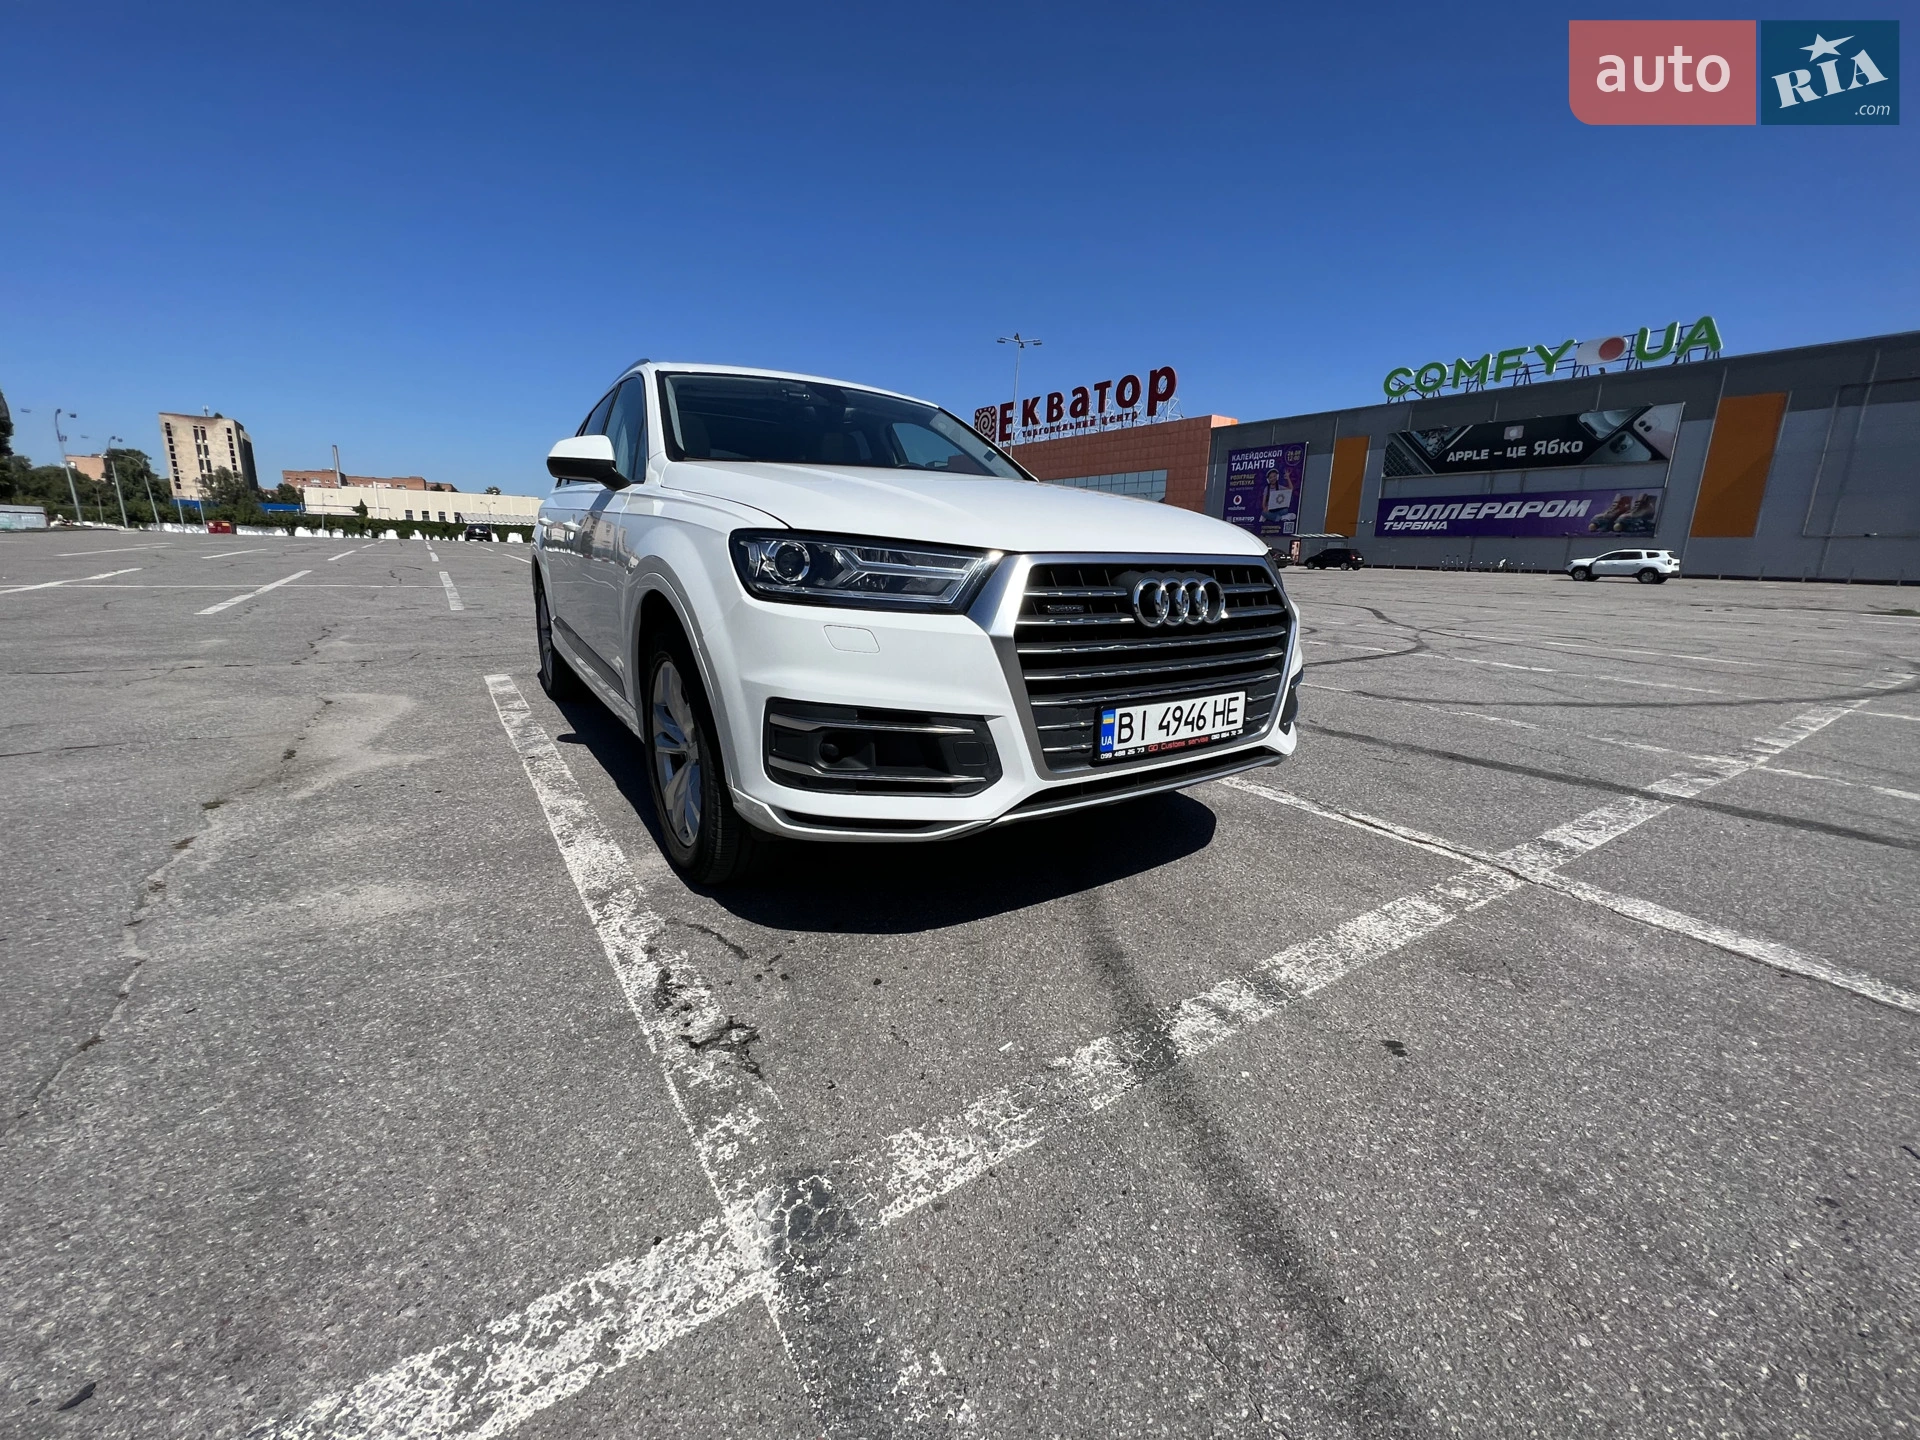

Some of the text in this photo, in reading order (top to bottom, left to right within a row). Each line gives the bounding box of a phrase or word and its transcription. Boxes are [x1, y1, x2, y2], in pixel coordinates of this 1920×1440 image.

[1383, 338, 1577, 398] COMFY
[1101, 411, 1138, 426] центр
[1231, 449, 1283, 462] КАЛЕЙДОСКОП
[1446, 448, 1490, 463] APPLE
[1506, 445, 1527, 460] ЦЕ
[1231, 459, 1275, 471] ТАЛАНТІВ
[1387, 499, 1592, 521] РОЛЛЕРДРОМ
[1383, 520, 1448, 531] ТУРБІНА
[1117, 696, 1240, 744] BI 4946 HE
[1101, 736, 1113, 746] UA
